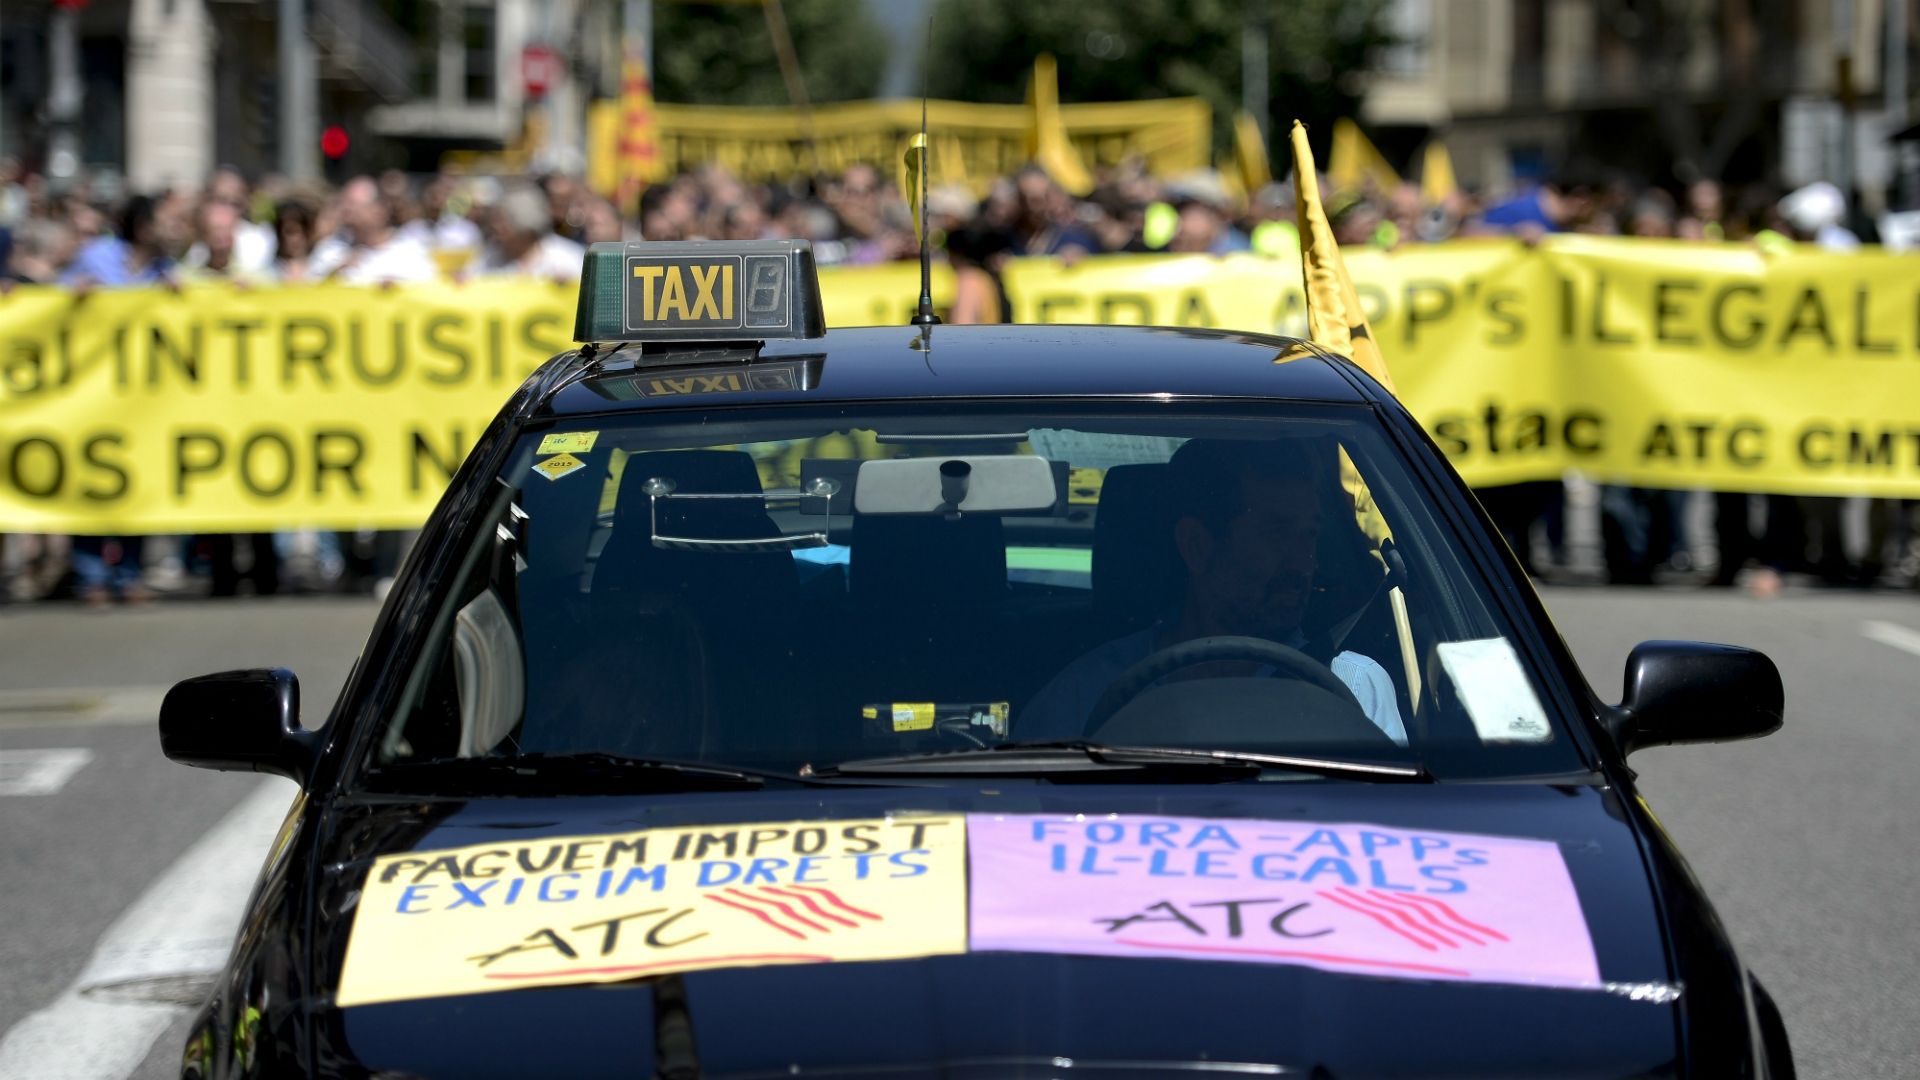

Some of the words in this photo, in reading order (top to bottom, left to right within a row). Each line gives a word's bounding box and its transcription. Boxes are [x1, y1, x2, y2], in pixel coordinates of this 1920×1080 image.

[633, 264, 734, 321] TAXI
[1558, 277, 1920, 355] ILEGAL
[173, 428, 365, 498] POR
[1641, 419, 1767, 467] ATC
[379, 837, 648, 883] PAGUEM
[672, 821, 950, 861] IMPOST
[396, 864, 667, 913] EXIGIM
[696, 849, 931, 887] DRETS
[1051, 843, 1469, 894] IL-LEGALS
[466, 908, 710, 967] ATC
[1092, 898, 1336, 939] ATC
